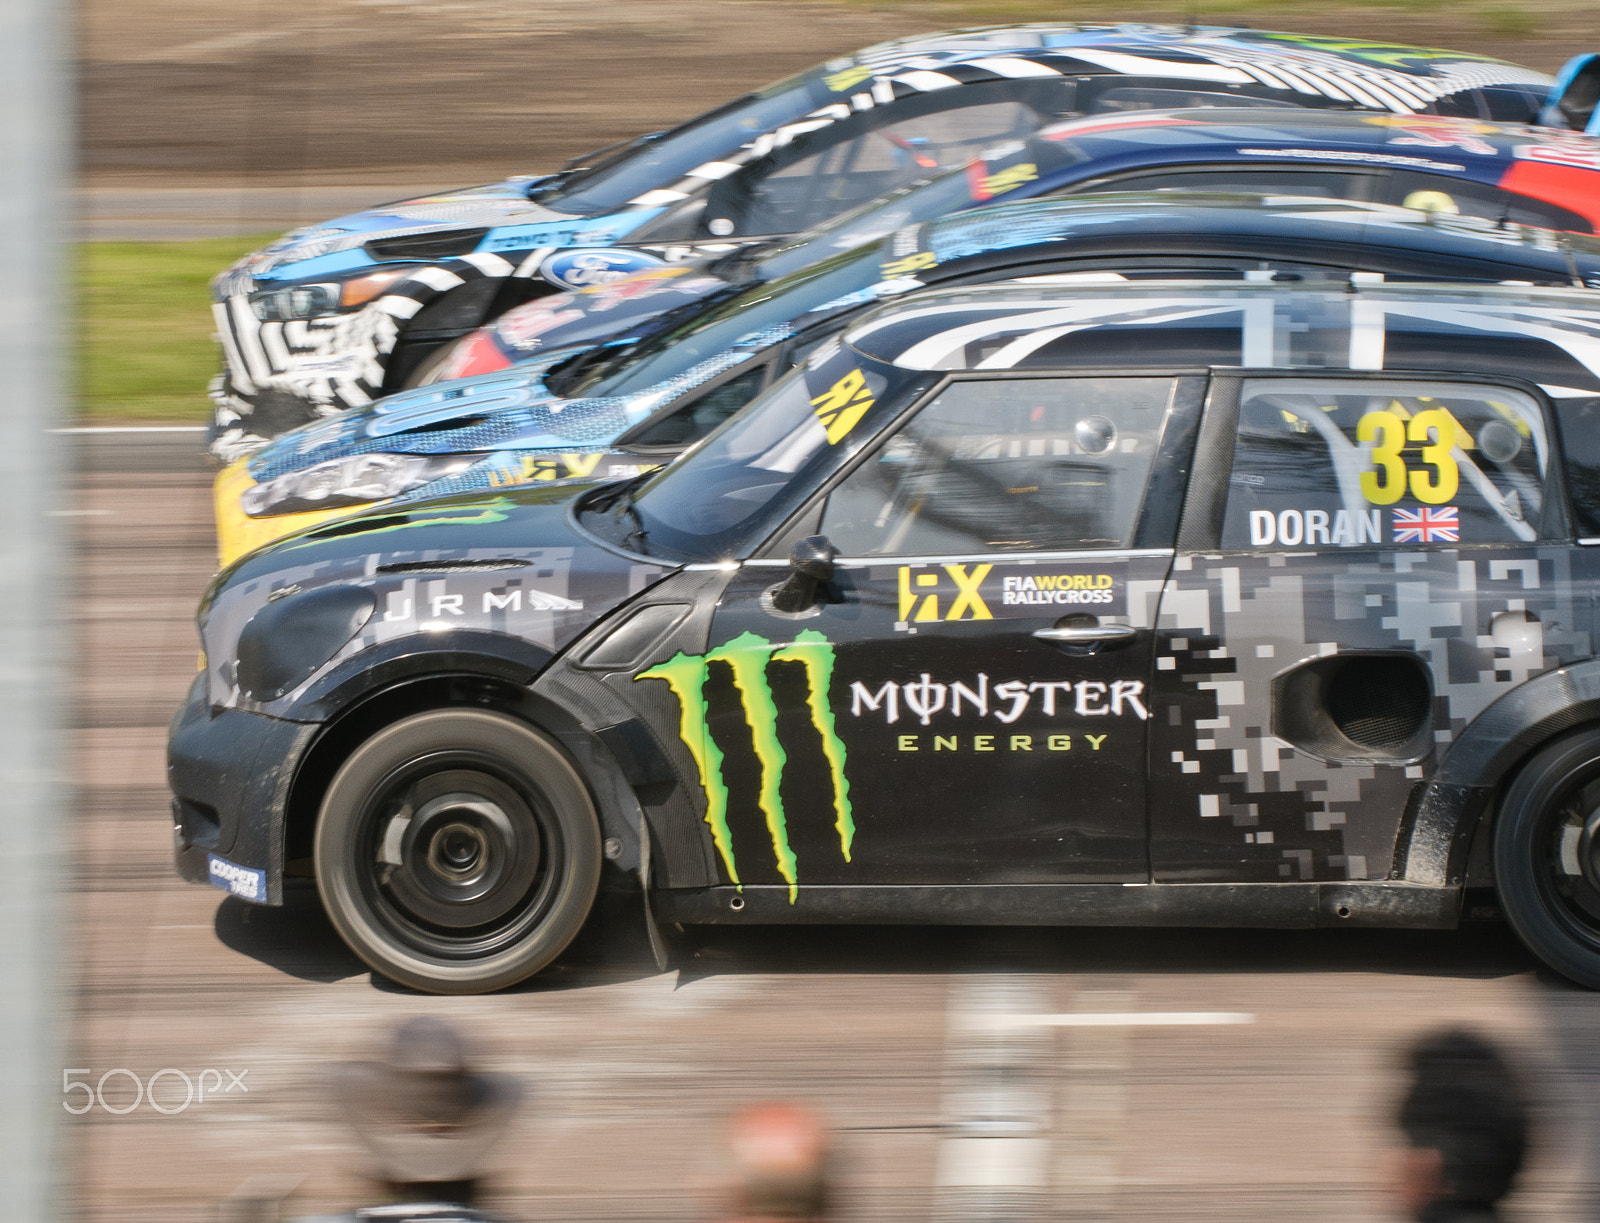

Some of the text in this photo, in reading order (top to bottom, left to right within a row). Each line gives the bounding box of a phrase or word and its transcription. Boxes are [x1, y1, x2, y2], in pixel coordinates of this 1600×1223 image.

[1356, 411, 1459, 505] 33
[1250, 509, 1382, 547] DORAN
[383, 590, 523, 622] JRM
[898, 564, 994, 622] RX
[1003, 590, 1114, 605] RALLYCROSS
[850, 672, 1148, 725] MONSTER
[898, 734, 1108, 751] ENERGY
[209, 858, 260, 887] COOPER
